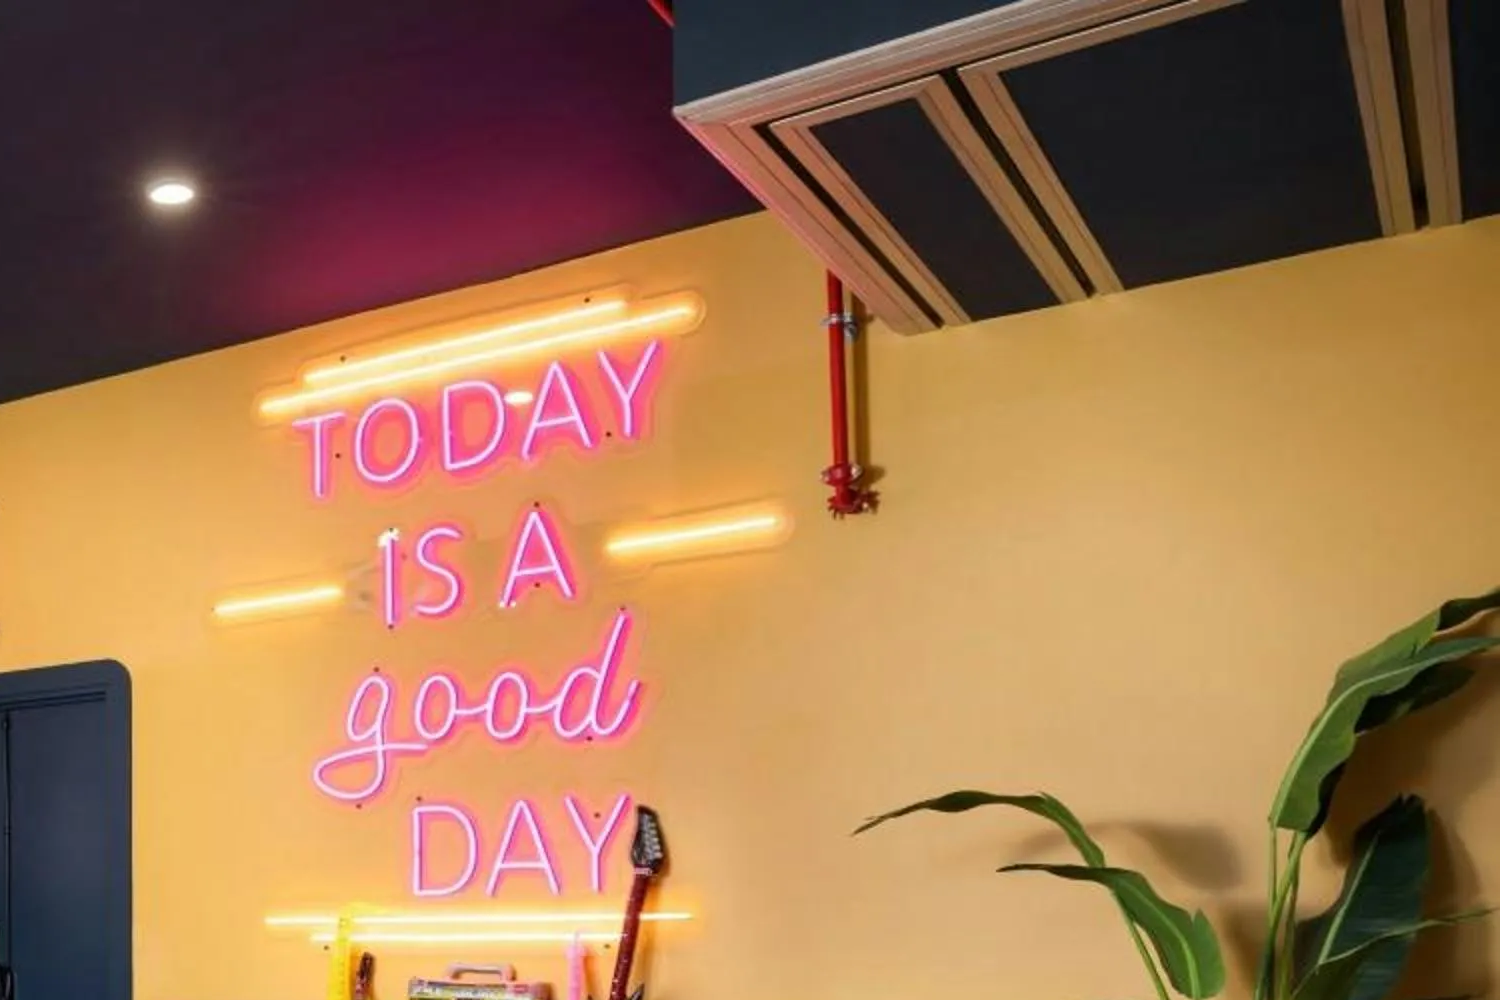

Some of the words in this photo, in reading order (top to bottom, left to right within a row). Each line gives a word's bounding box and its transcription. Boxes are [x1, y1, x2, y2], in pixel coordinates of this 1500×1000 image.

[291, 339, 662, 498] TODAY
[383, 527, 464, 626] IS
[502, 510, 574, 607] A
[313, 610, 641, 801] good
[411, 793, 631, 896] DAY
